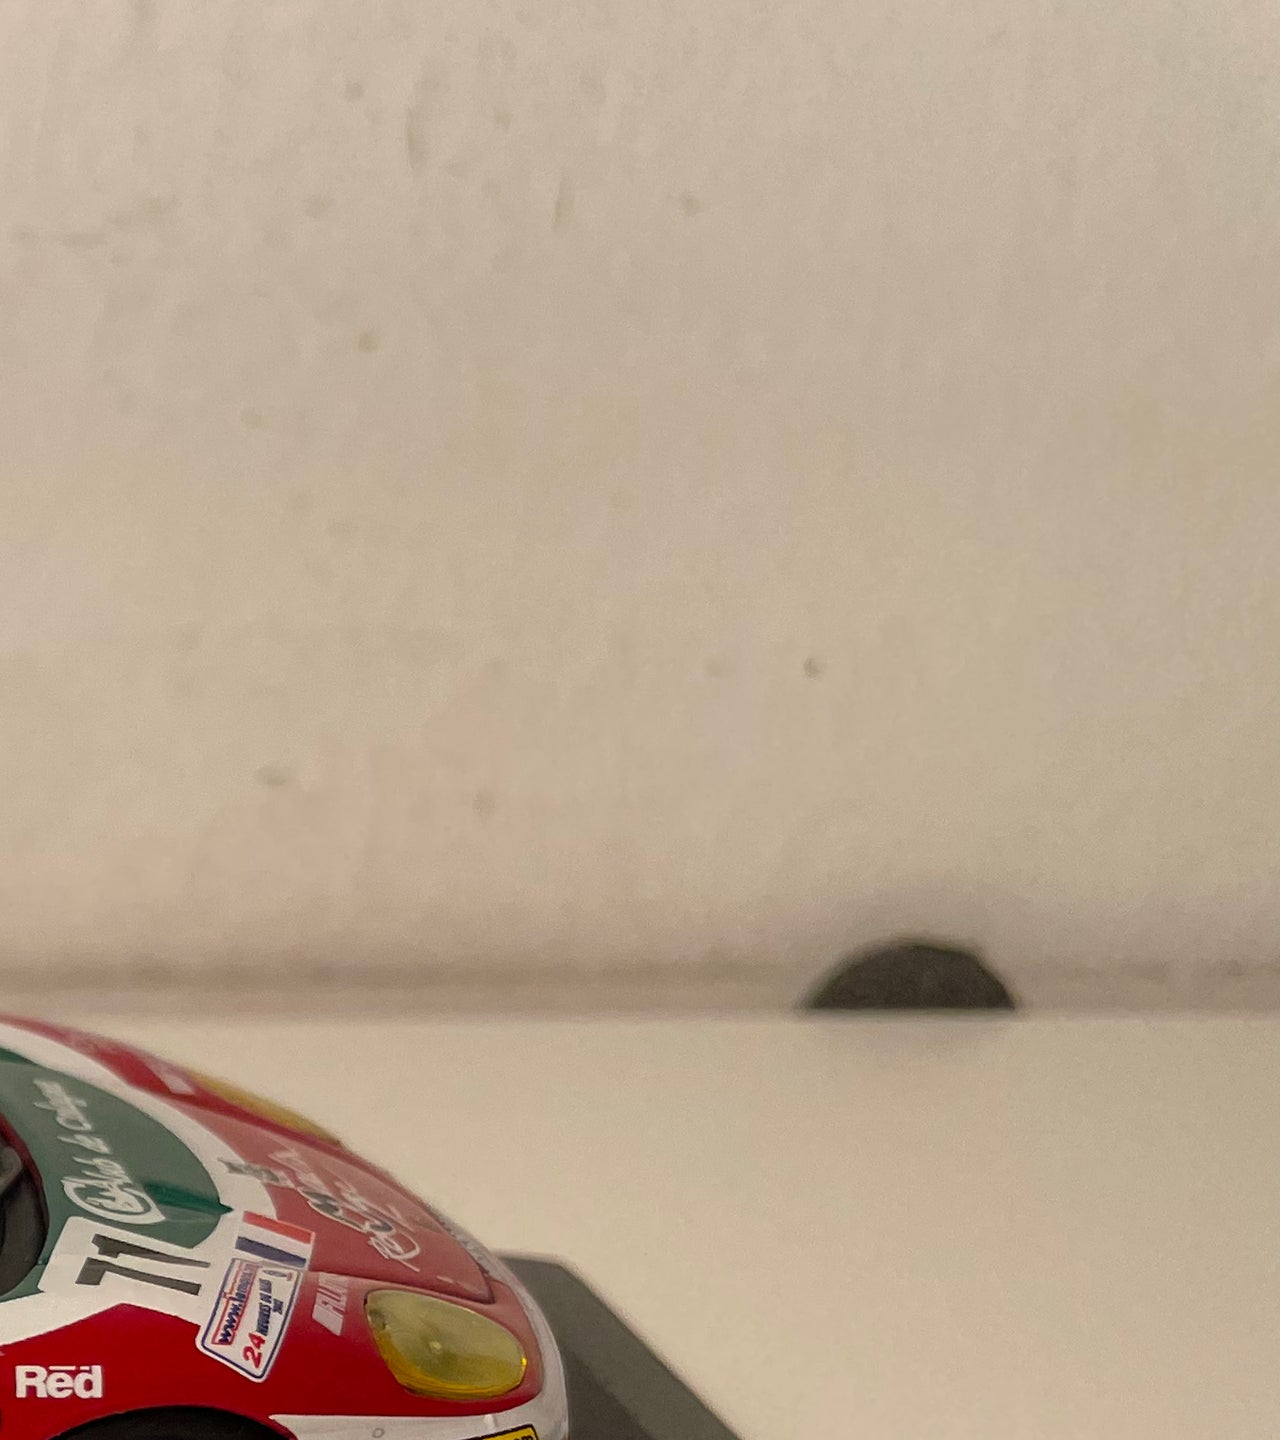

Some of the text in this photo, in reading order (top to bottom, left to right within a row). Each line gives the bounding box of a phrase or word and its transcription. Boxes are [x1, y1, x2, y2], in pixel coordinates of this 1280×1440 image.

[75, 1233, 211, 1296] 71
[243, 1333, 266, 1369] 24
[15, 1364, 103, 1399] Red
